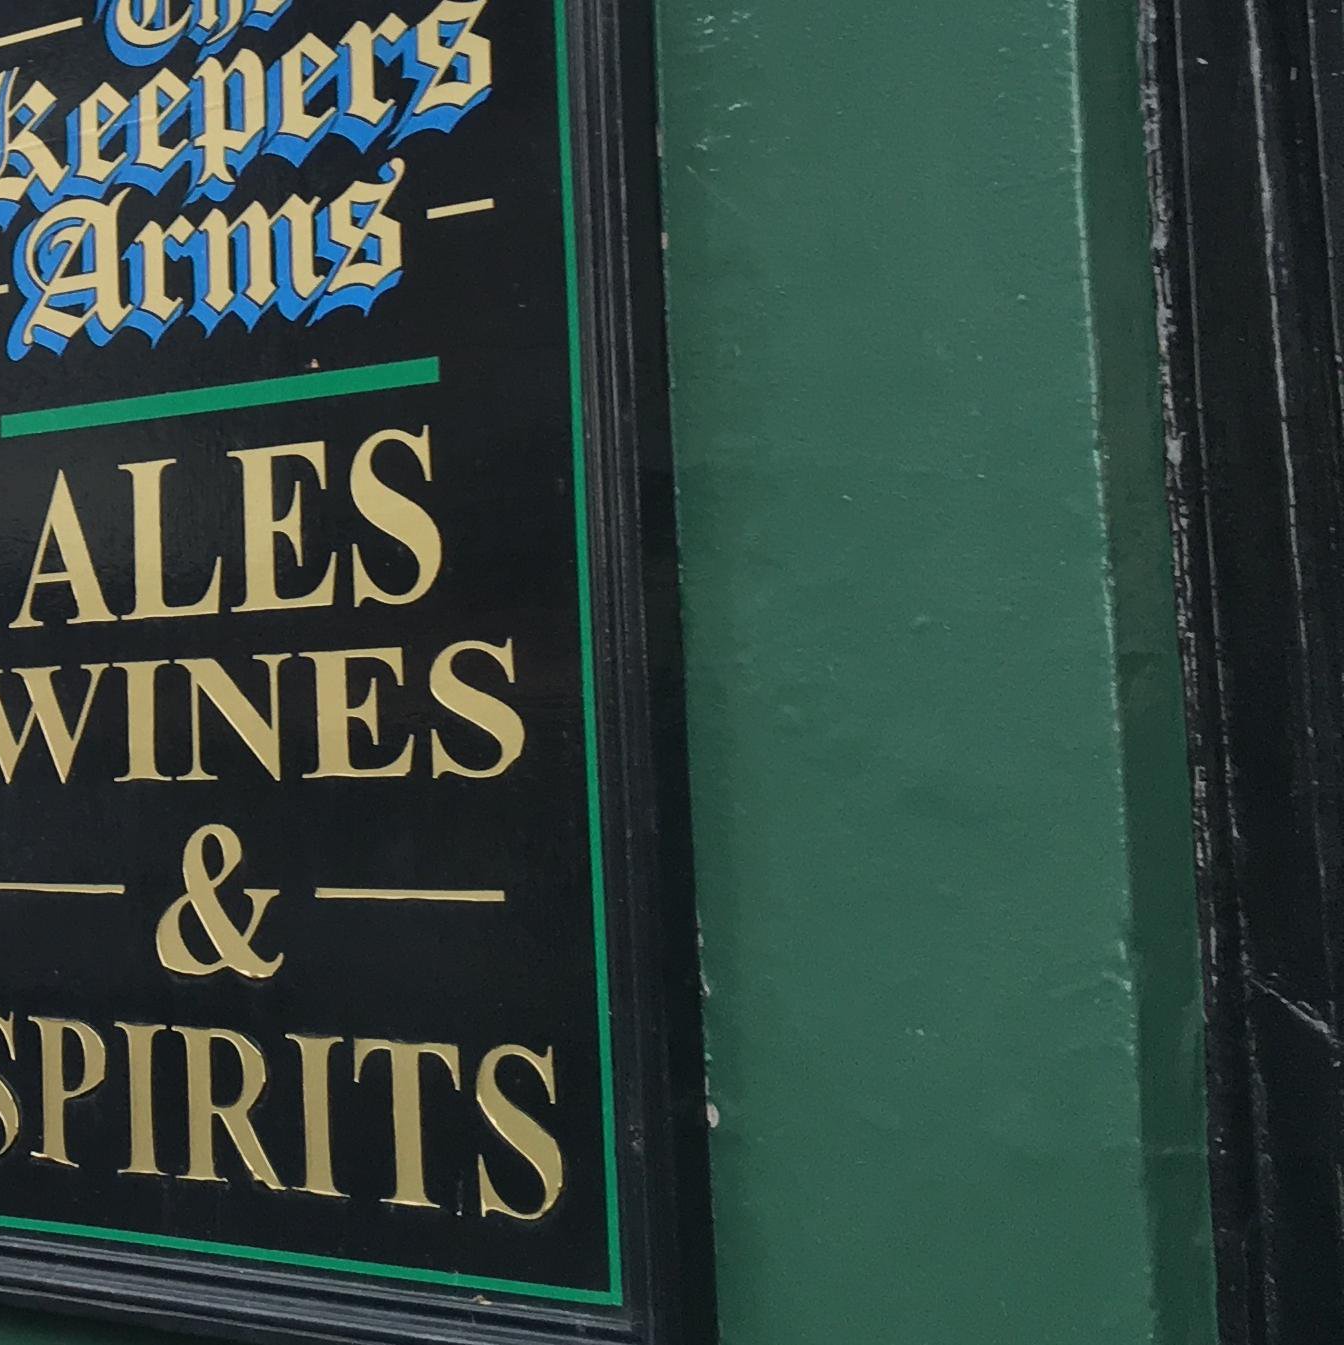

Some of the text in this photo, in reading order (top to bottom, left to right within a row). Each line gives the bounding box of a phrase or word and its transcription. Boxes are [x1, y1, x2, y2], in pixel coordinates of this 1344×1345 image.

[6, 157, 407, 361] Arms
[8, 424, 444, 629] ALES
[155, 823, 286, 979] &
